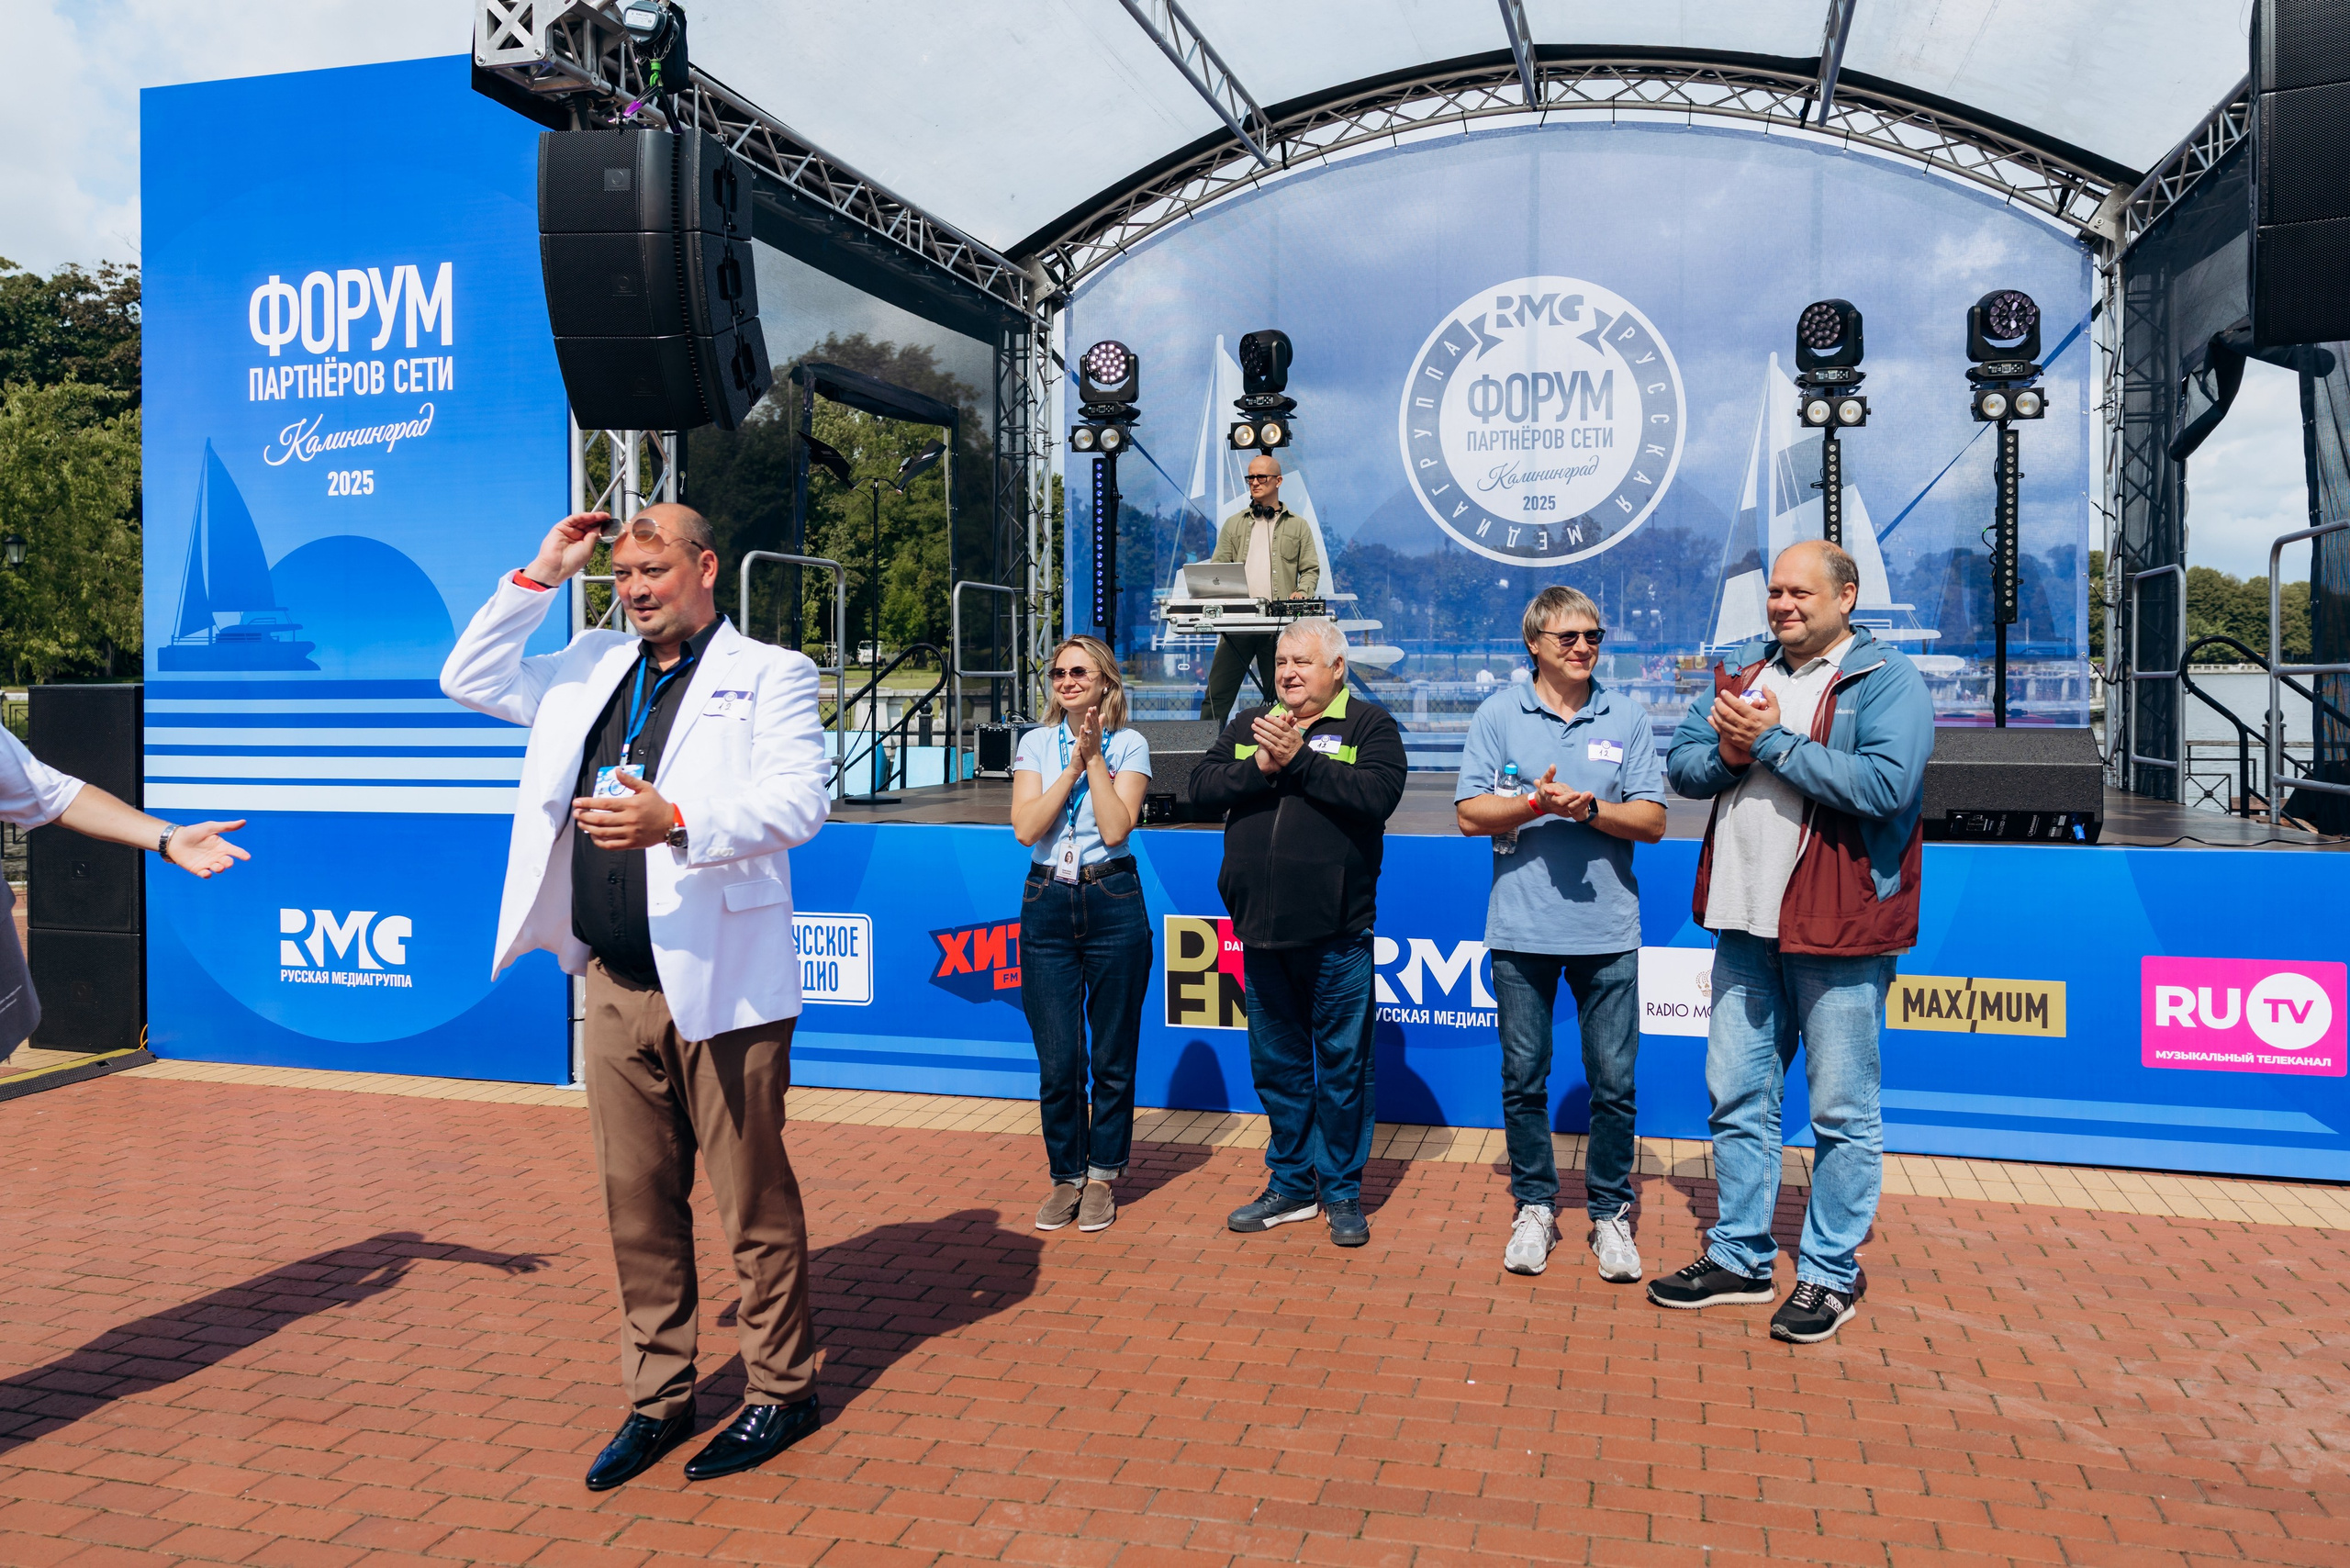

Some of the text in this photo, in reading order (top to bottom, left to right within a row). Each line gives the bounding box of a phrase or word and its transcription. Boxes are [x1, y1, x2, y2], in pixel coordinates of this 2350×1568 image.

[249, 262, 453, 356] ФОРУМ
[1495, 293, 1584, 329] RMG
[249, 355, 453, 401] ПАРТНЁРОВ СЕТИ
[1467, 369, 1614, 424] ФОРУМ
[263, 402, 435, 466] Калининград
[1414, 326, 1670, 551] РУССКАЯ МЕДИАГРУППА
[1467, 425, 1614, 452] ПАРТНЁРОВ СЕТИ
[327, 470, 375, 497] 2025
[1476, 454, 1600, 492] Калининград
[1522, 495, 1556, 511] 2025
[1599, 749, 1609, 757] 12
[280, 908, 412, 969] RMG
[792, 924, 858, 958] УССКОЕ
[280, 969, 412, 987] РУССКАЯ МЕДИАГРУППА
[799, 960, 838, 991] ДИО
[1003, 972, 1018, 983] FM
[1374, 936, 1498, 1008] RM
[1376, 1007, 1429, 1024] УССКАЯ
[1646, 1002, 1689, 1017] RADIO
[2155, 985, 2314, 1029] RU TV
[2155, 1049, 2332, 1068] МУЗЫКАЛЬНЫЙ ТЕЛЕКАНАЛ
